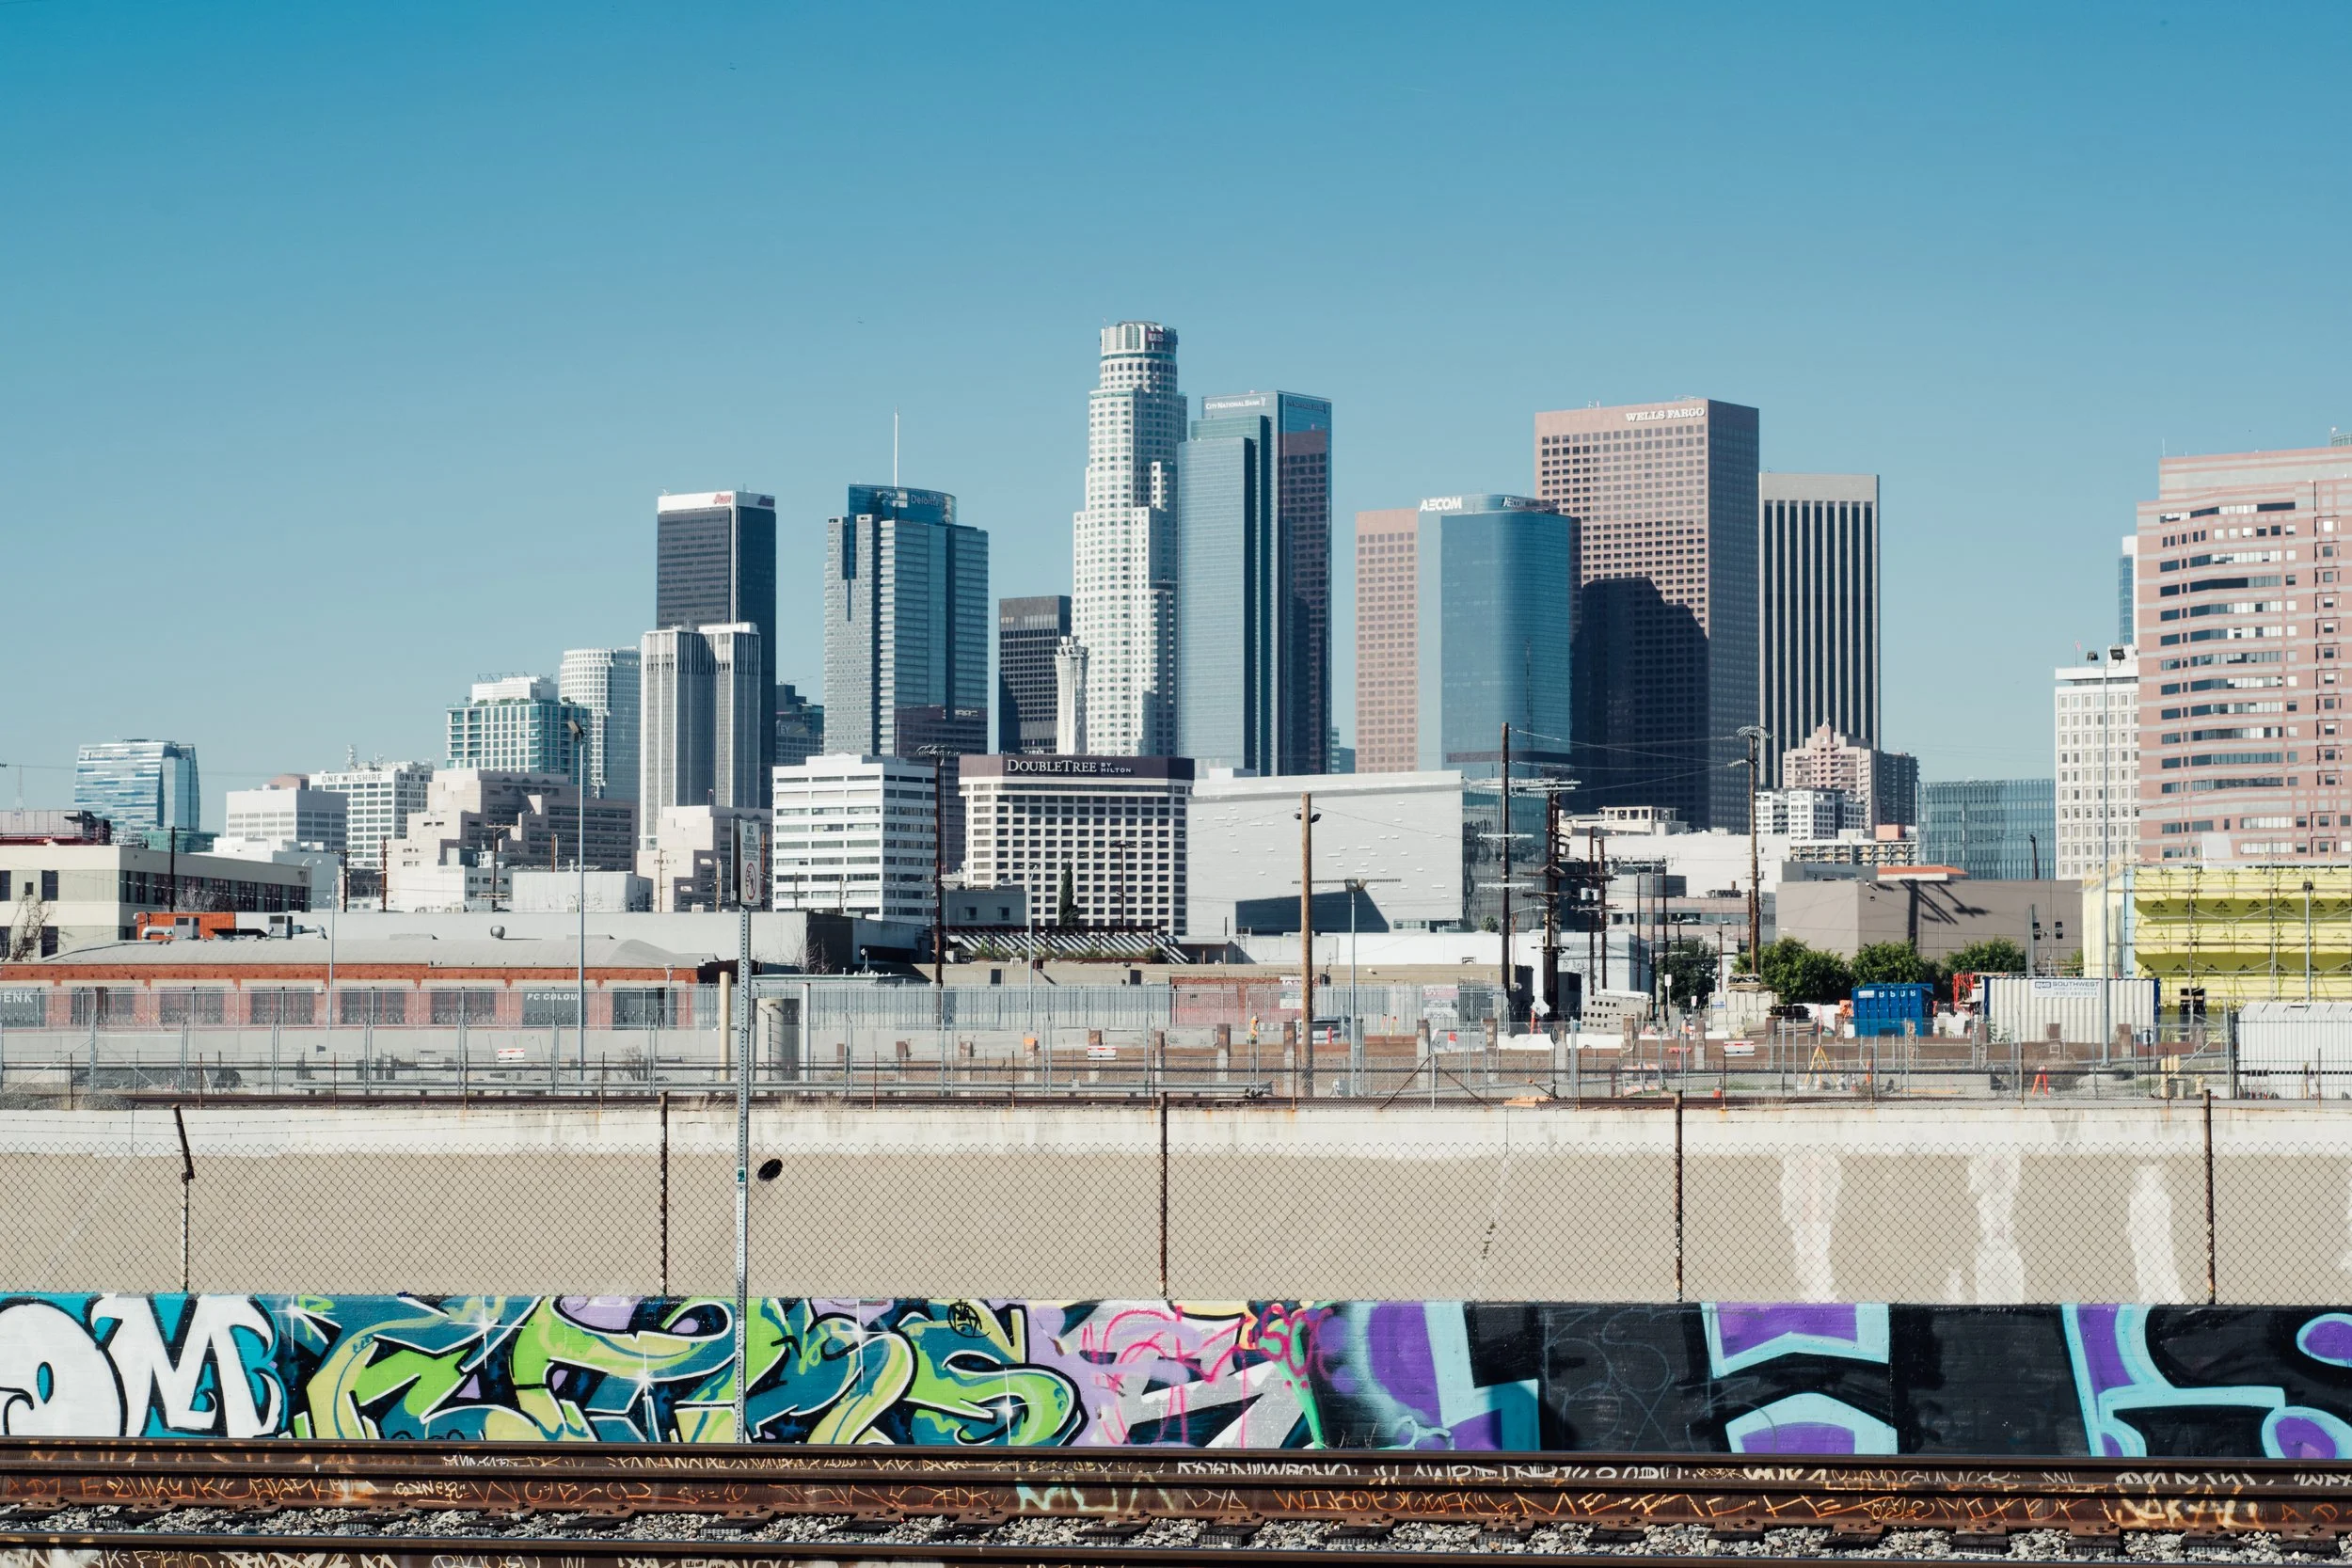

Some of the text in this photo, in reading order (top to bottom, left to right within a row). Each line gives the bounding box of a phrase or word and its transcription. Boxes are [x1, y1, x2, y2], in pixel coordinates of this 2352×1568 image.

[1626, 407, 1705, 422] WELLS FARGO
[1419, 497, 1462, 512] AECOM
[322, 773, 383, 784] ONE WILSHIRE
[399, 773, 416, 782] ONE
[0, 991, 33, 1003] ENK
